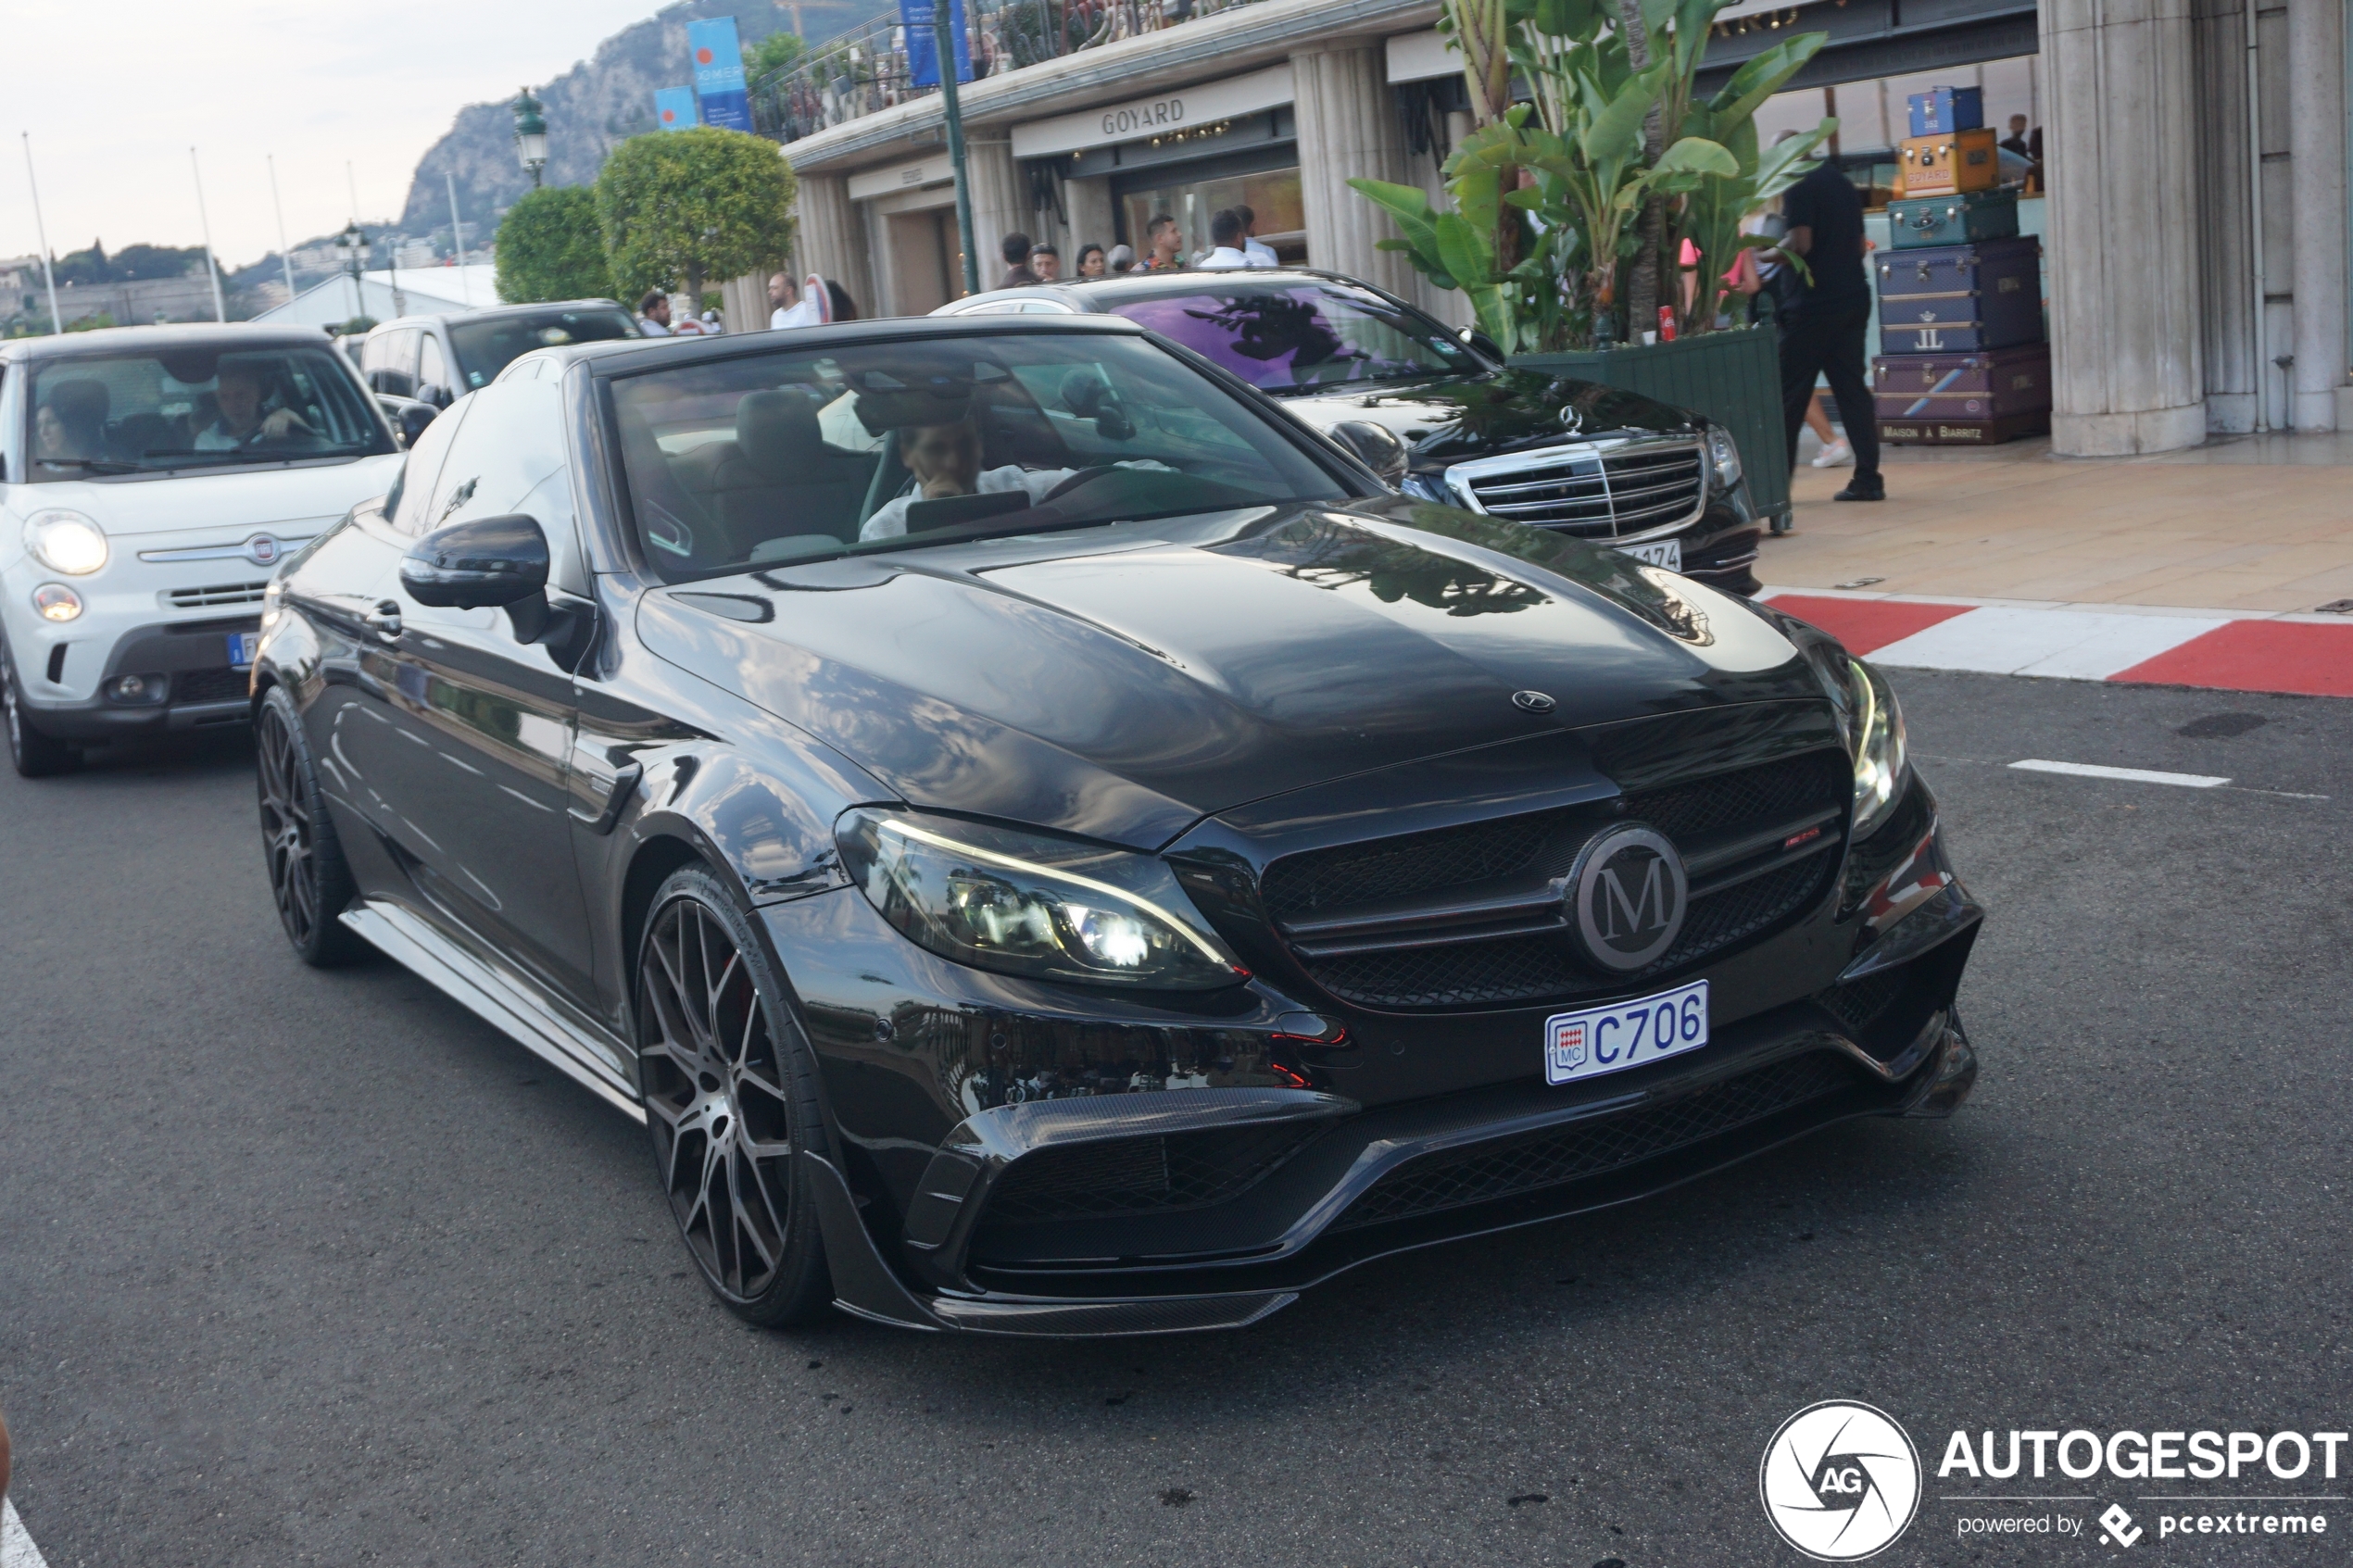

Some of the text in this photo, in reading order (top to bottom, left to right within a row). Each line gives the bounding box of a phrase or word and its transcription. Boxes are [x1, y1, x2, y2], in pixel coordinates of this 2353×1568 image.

[1102, 99, 1184, 134] GOYARD
[1908, 169, 1950, 183] GOYARD
[1600, 856, 1668, 941] M
[1561, 994, 1701, 1064] MC C706
